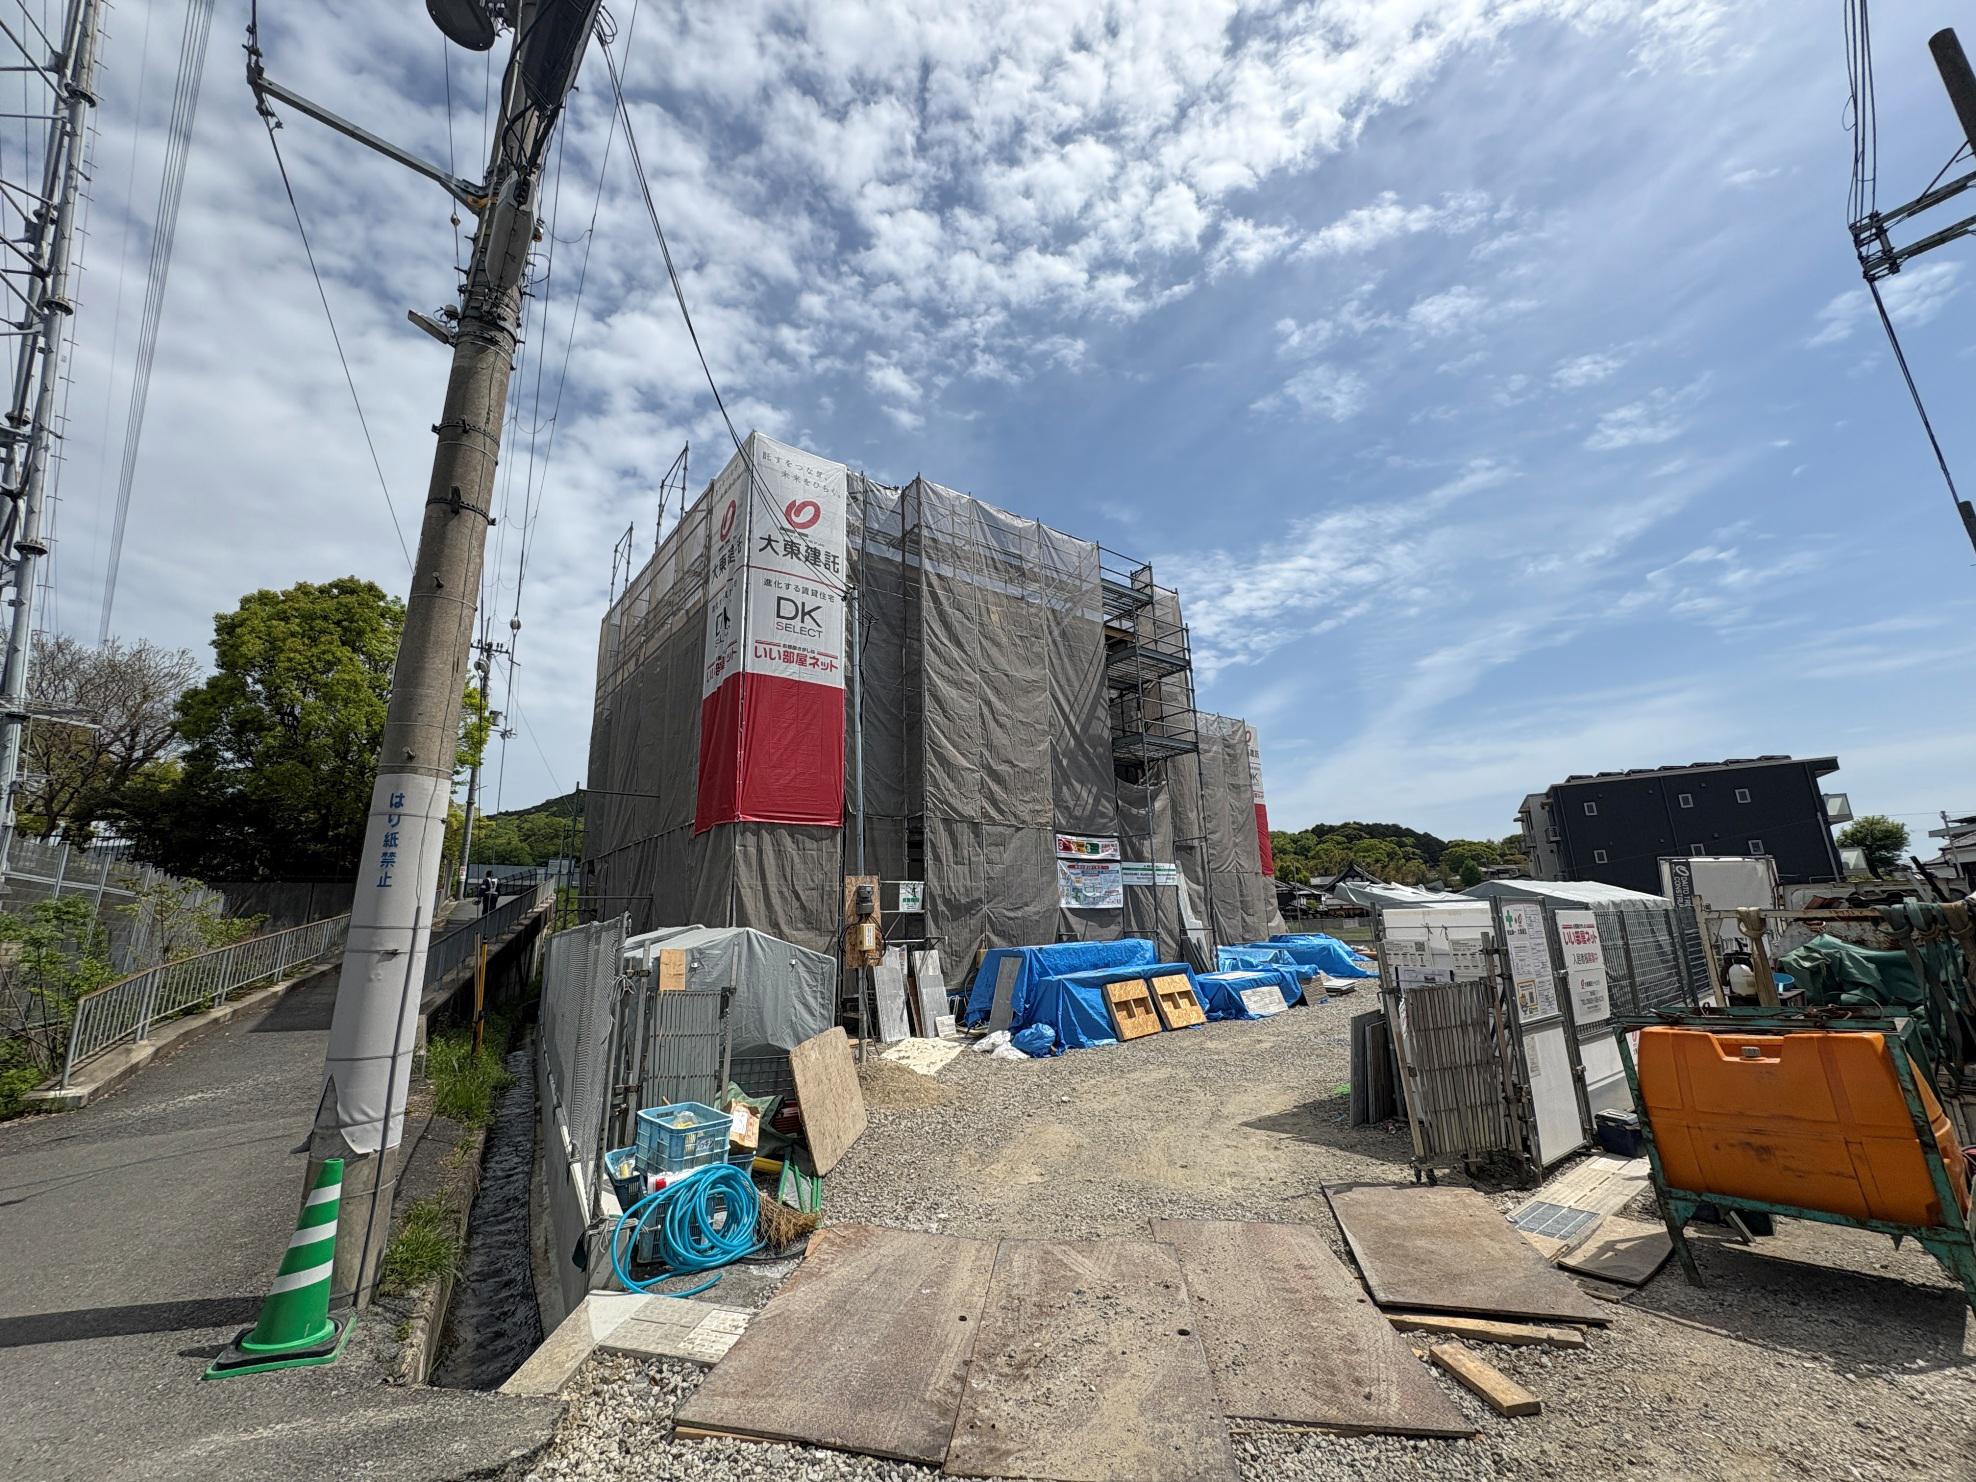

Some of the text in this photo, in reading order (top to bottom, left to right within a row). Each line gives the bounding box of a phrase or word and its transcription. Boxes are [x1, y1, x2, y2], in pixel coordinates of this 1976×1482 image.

[758, 534, 840, 574] 大東建託
[763, 578, 835, 603] 進化する賃貸住宅
[776, 596, 823, 628] DK
[776, 621, 824, 638] SELECT
[753, 645, 838, 672] いい部屋ネット
[377, 792, 406, 888] はり紙禁止
